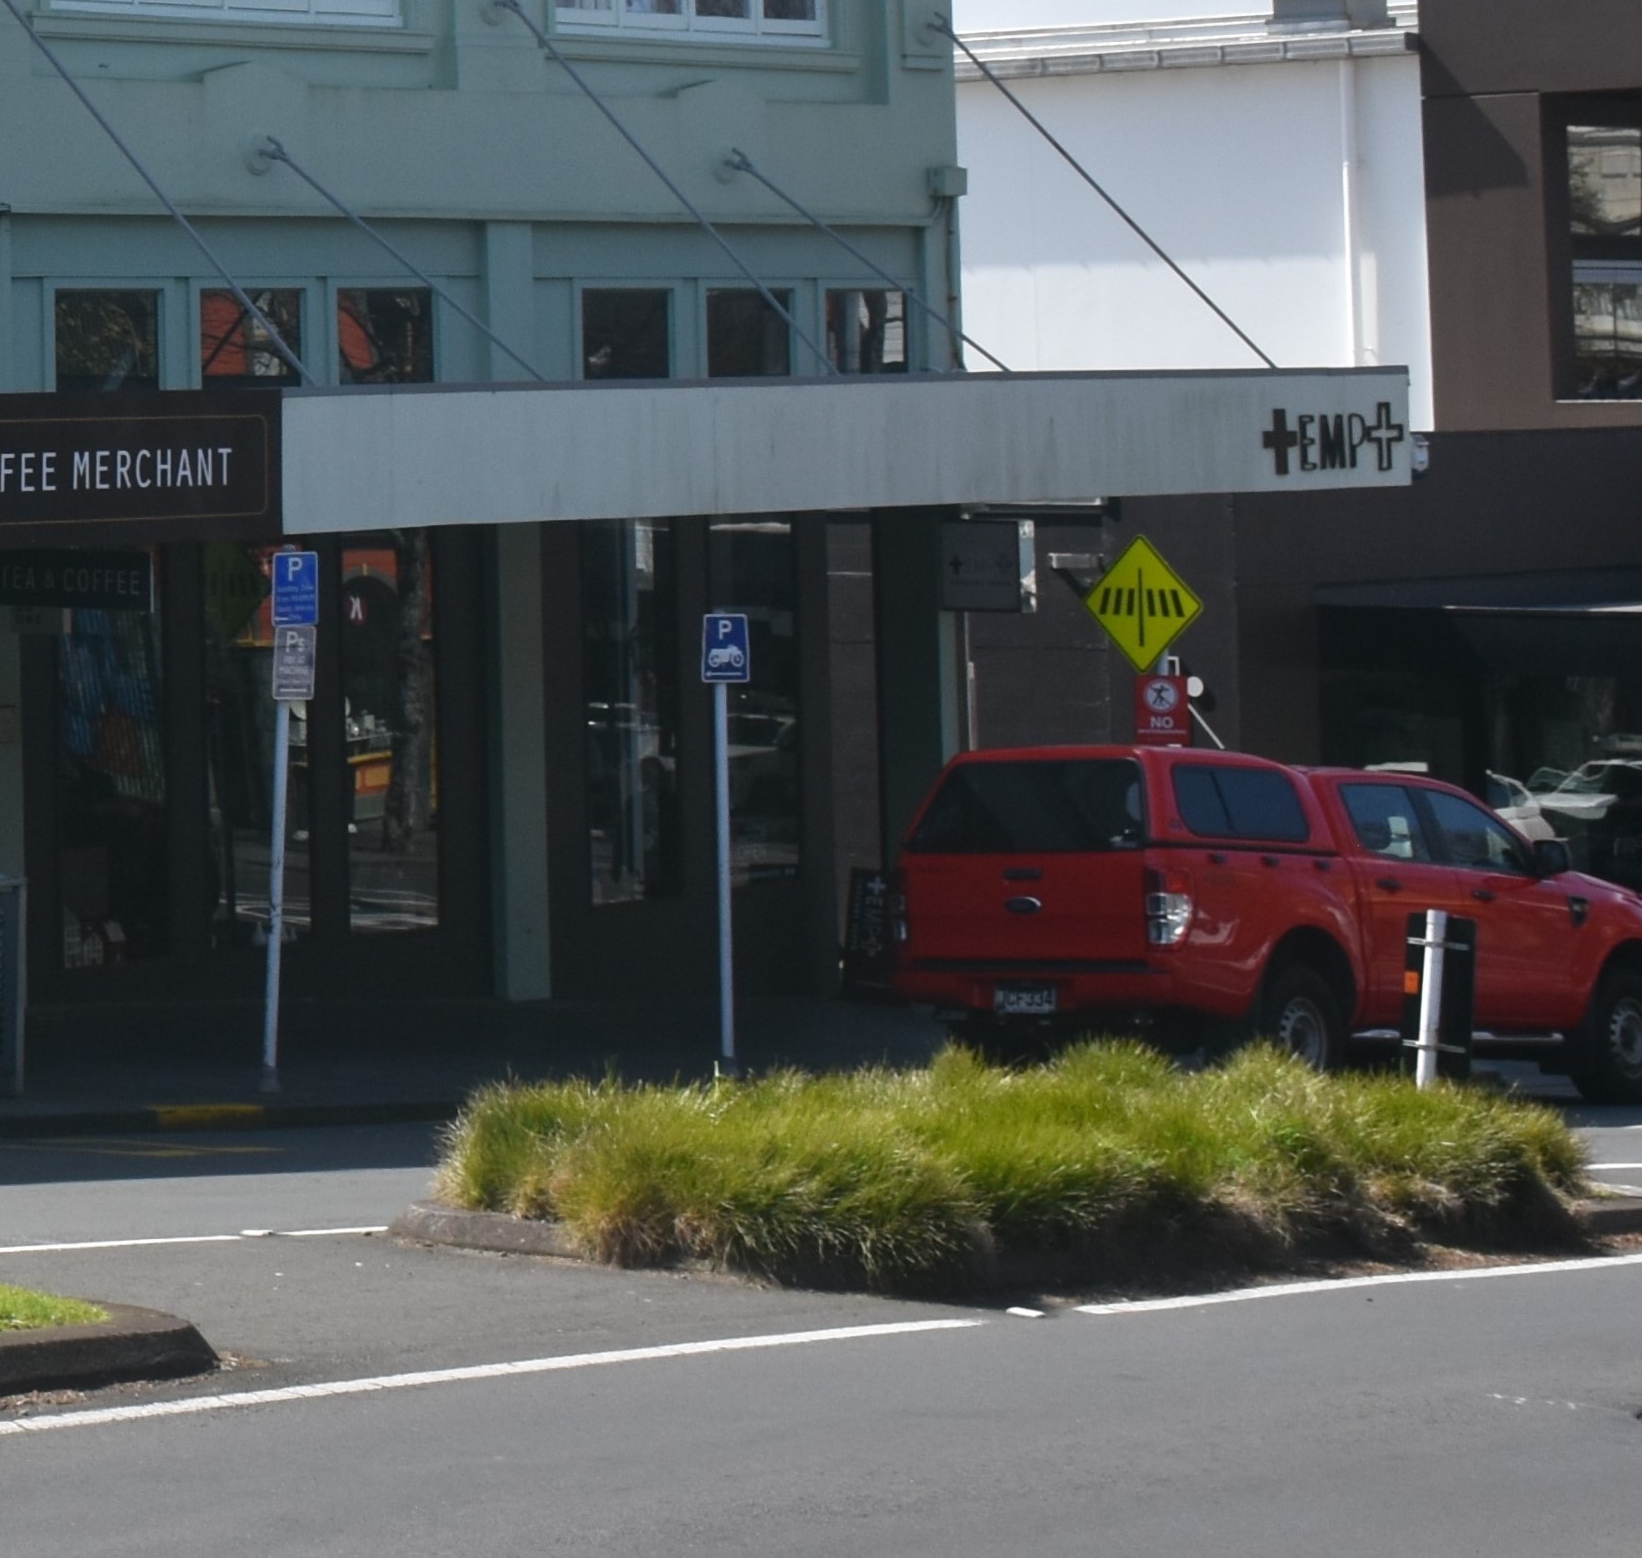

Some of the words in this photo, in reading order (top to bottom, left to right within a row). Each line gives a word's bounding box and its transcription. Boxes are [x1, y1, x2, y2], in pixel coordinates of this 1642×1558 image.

[73, 448, 233, 490] MERCHANT
[288, 557, 304, 581] P
[63, 569, 141, 595] COFFEE
[718, 620, 733, 640] P
[1150, 716, 1174, 728] NO
